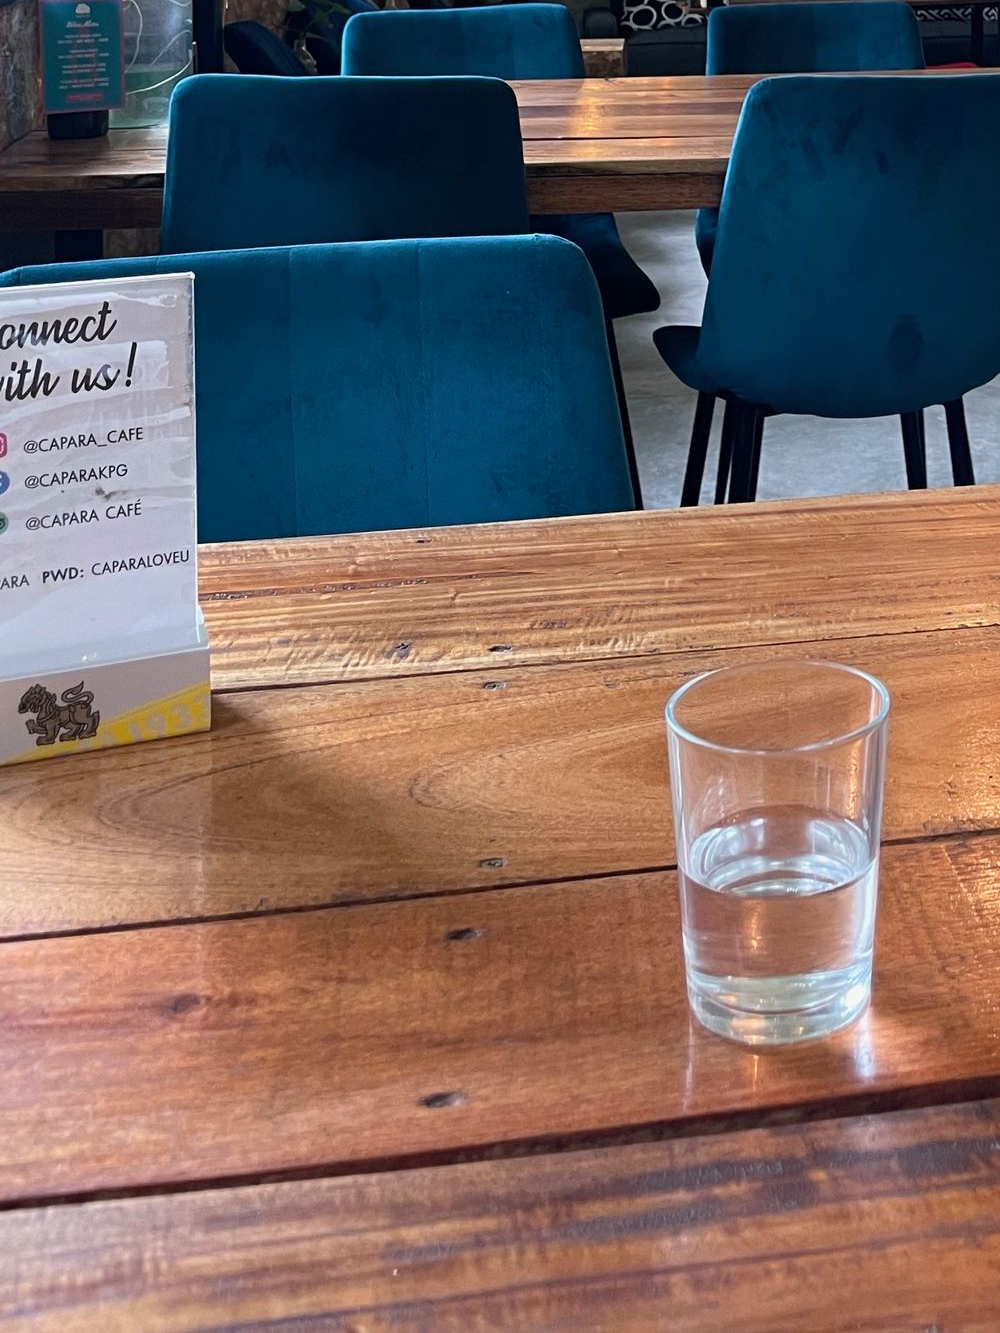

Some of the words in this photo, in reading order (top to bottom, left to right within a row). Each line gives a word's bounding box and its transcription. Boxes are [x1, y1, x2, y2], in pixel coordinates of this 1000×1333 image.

[0, 301, 117, 350] onnect
[0, 357, 61, 402] ith
[71, 341, 138, 393] us!
[23, 427, 144, 454] @CAPARA_CAFE
[24, 463, 128, 489] @CAPARAKPG
[25, 509, 99, 532] @CAPARA
[105, 499, 142, 521] CAFÉ
[0, 574, 30, 590] ARA
[42, 567, 85, 584] PWD:
[91, 550, 190, 576] CAPARALOVEU
